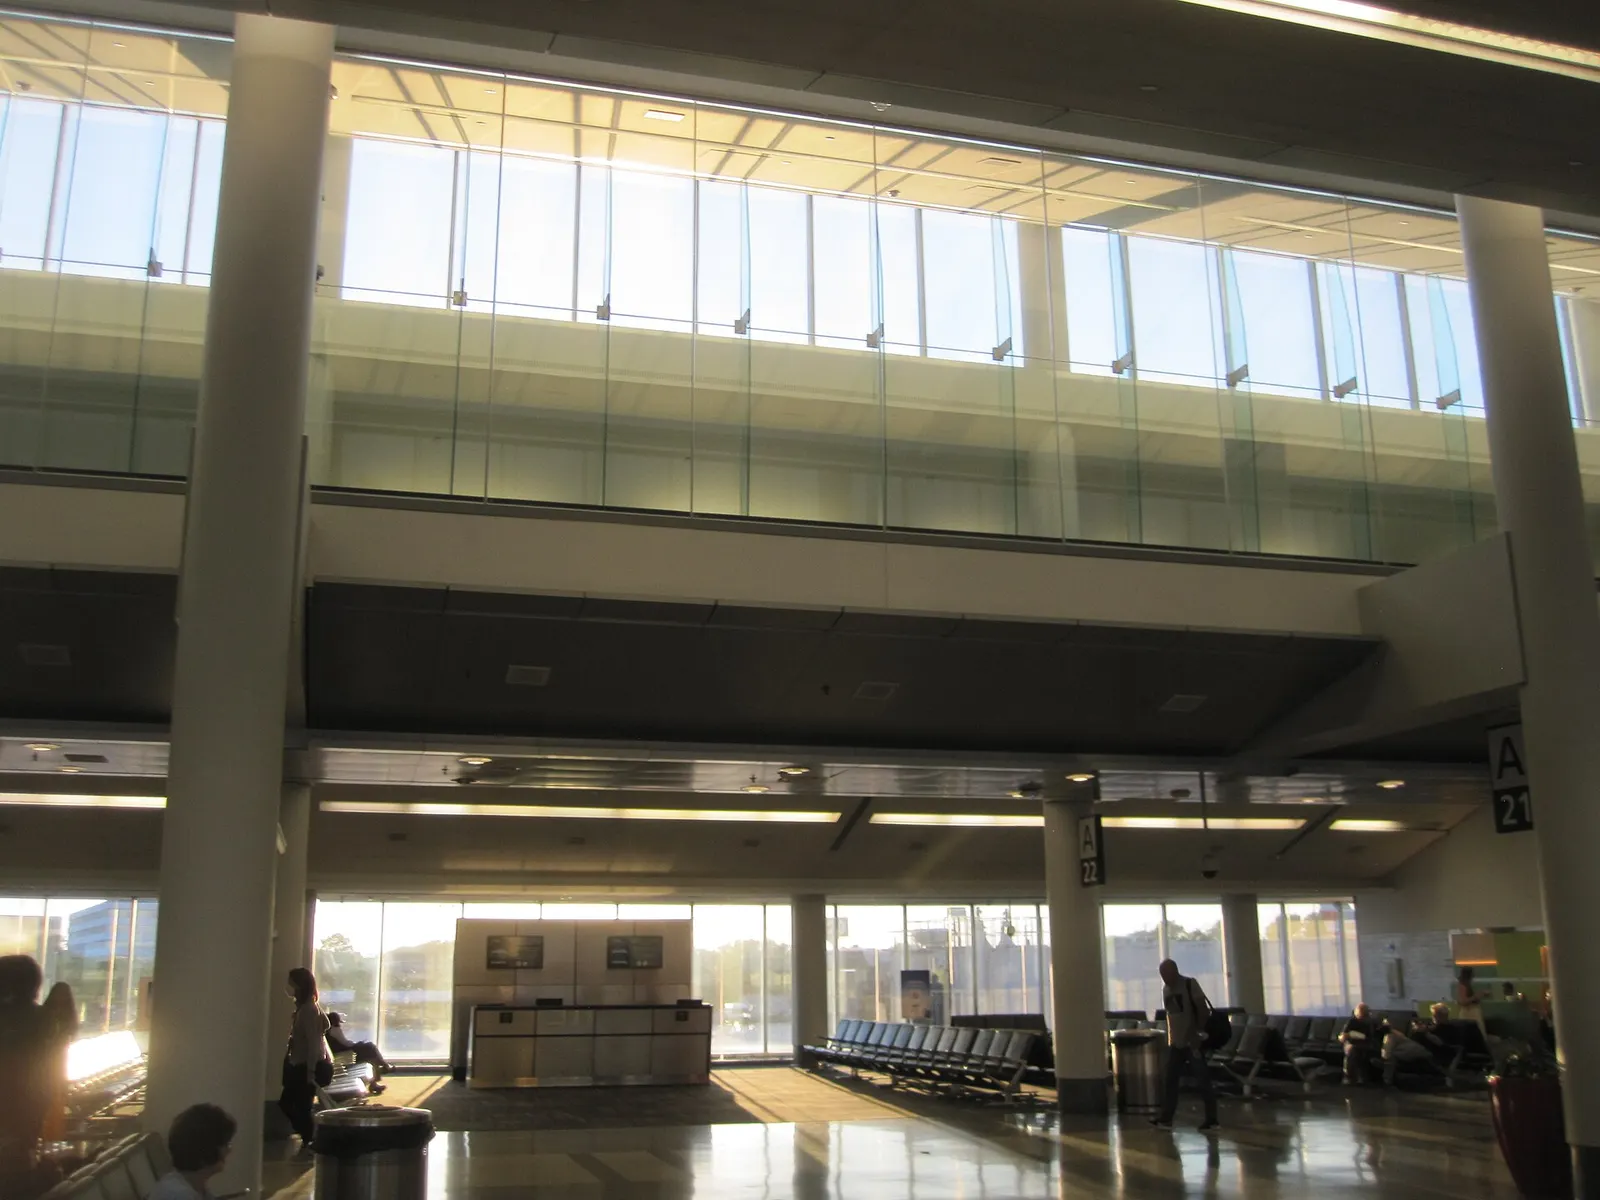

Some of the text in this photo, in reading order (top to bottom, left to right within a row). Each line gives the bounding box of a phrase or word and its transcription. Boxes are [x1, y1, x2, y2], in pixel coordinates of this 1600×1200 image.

[1497, 736, 1525, 779] A
[1500, 791, 1531, 826] 21
[1083, 825, 1094, 853] A
[1083, 861, 1097, 883] 22
